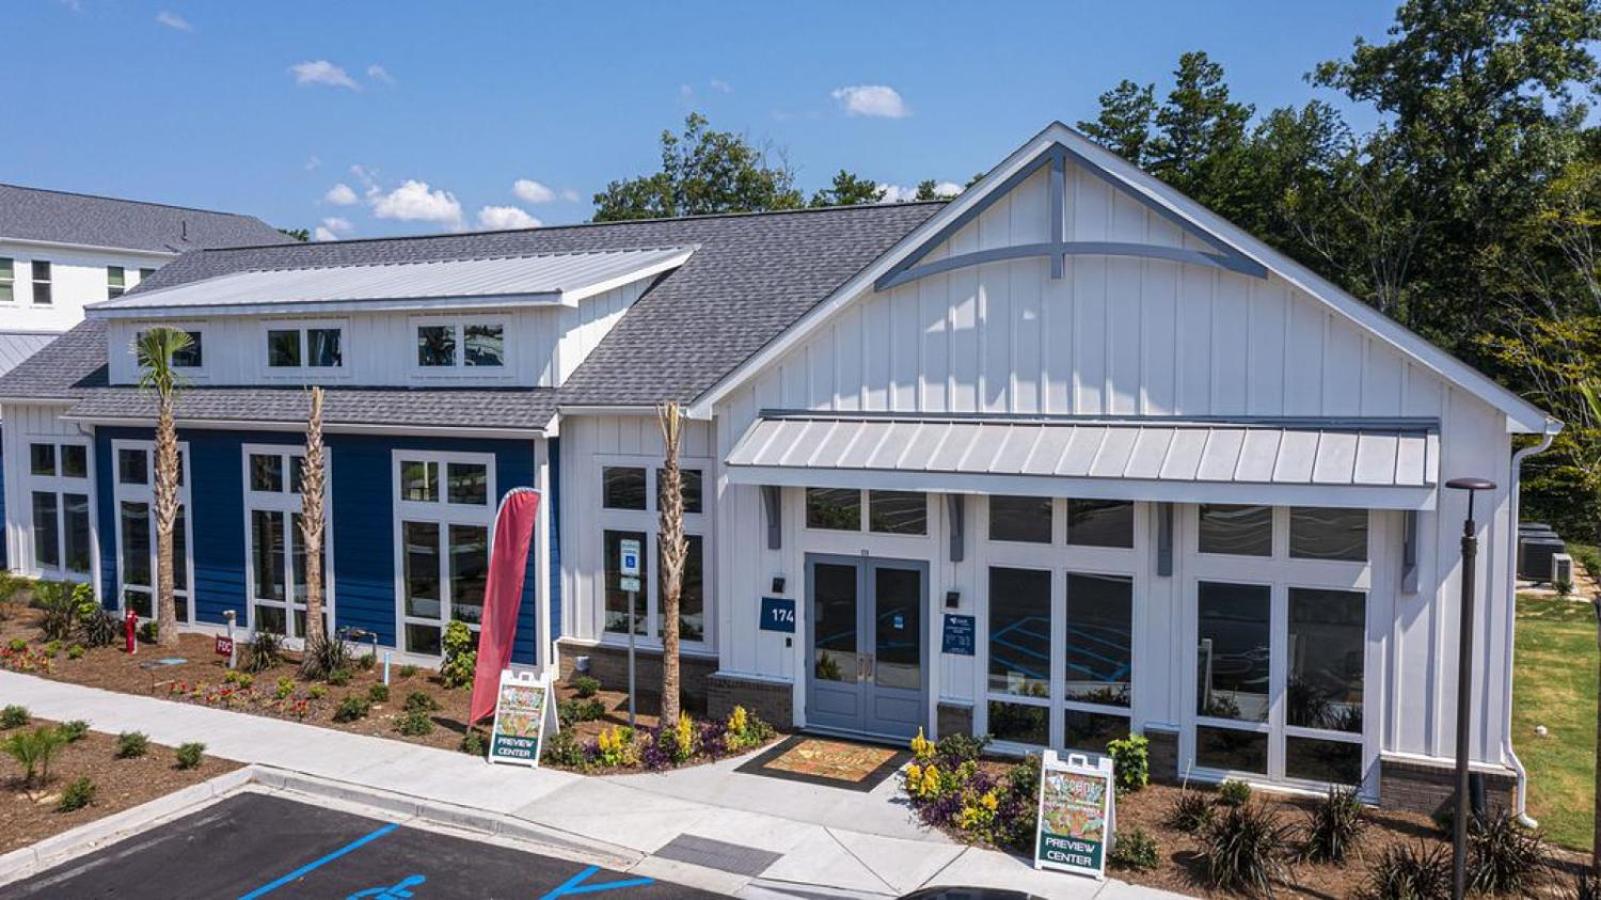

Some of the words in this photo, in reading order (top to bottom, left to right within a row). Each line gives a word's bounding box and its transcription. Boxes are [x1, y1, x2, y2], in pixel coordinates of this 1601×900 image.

[772, 608, 794, 623] 174
[498, 737, 534, 747] PREVIEW
[498, 747, 530, 756] CENTER
[1045, 837, 1095, 854] PREVIEW
[1047, 850, 1092, 866] CENTER
